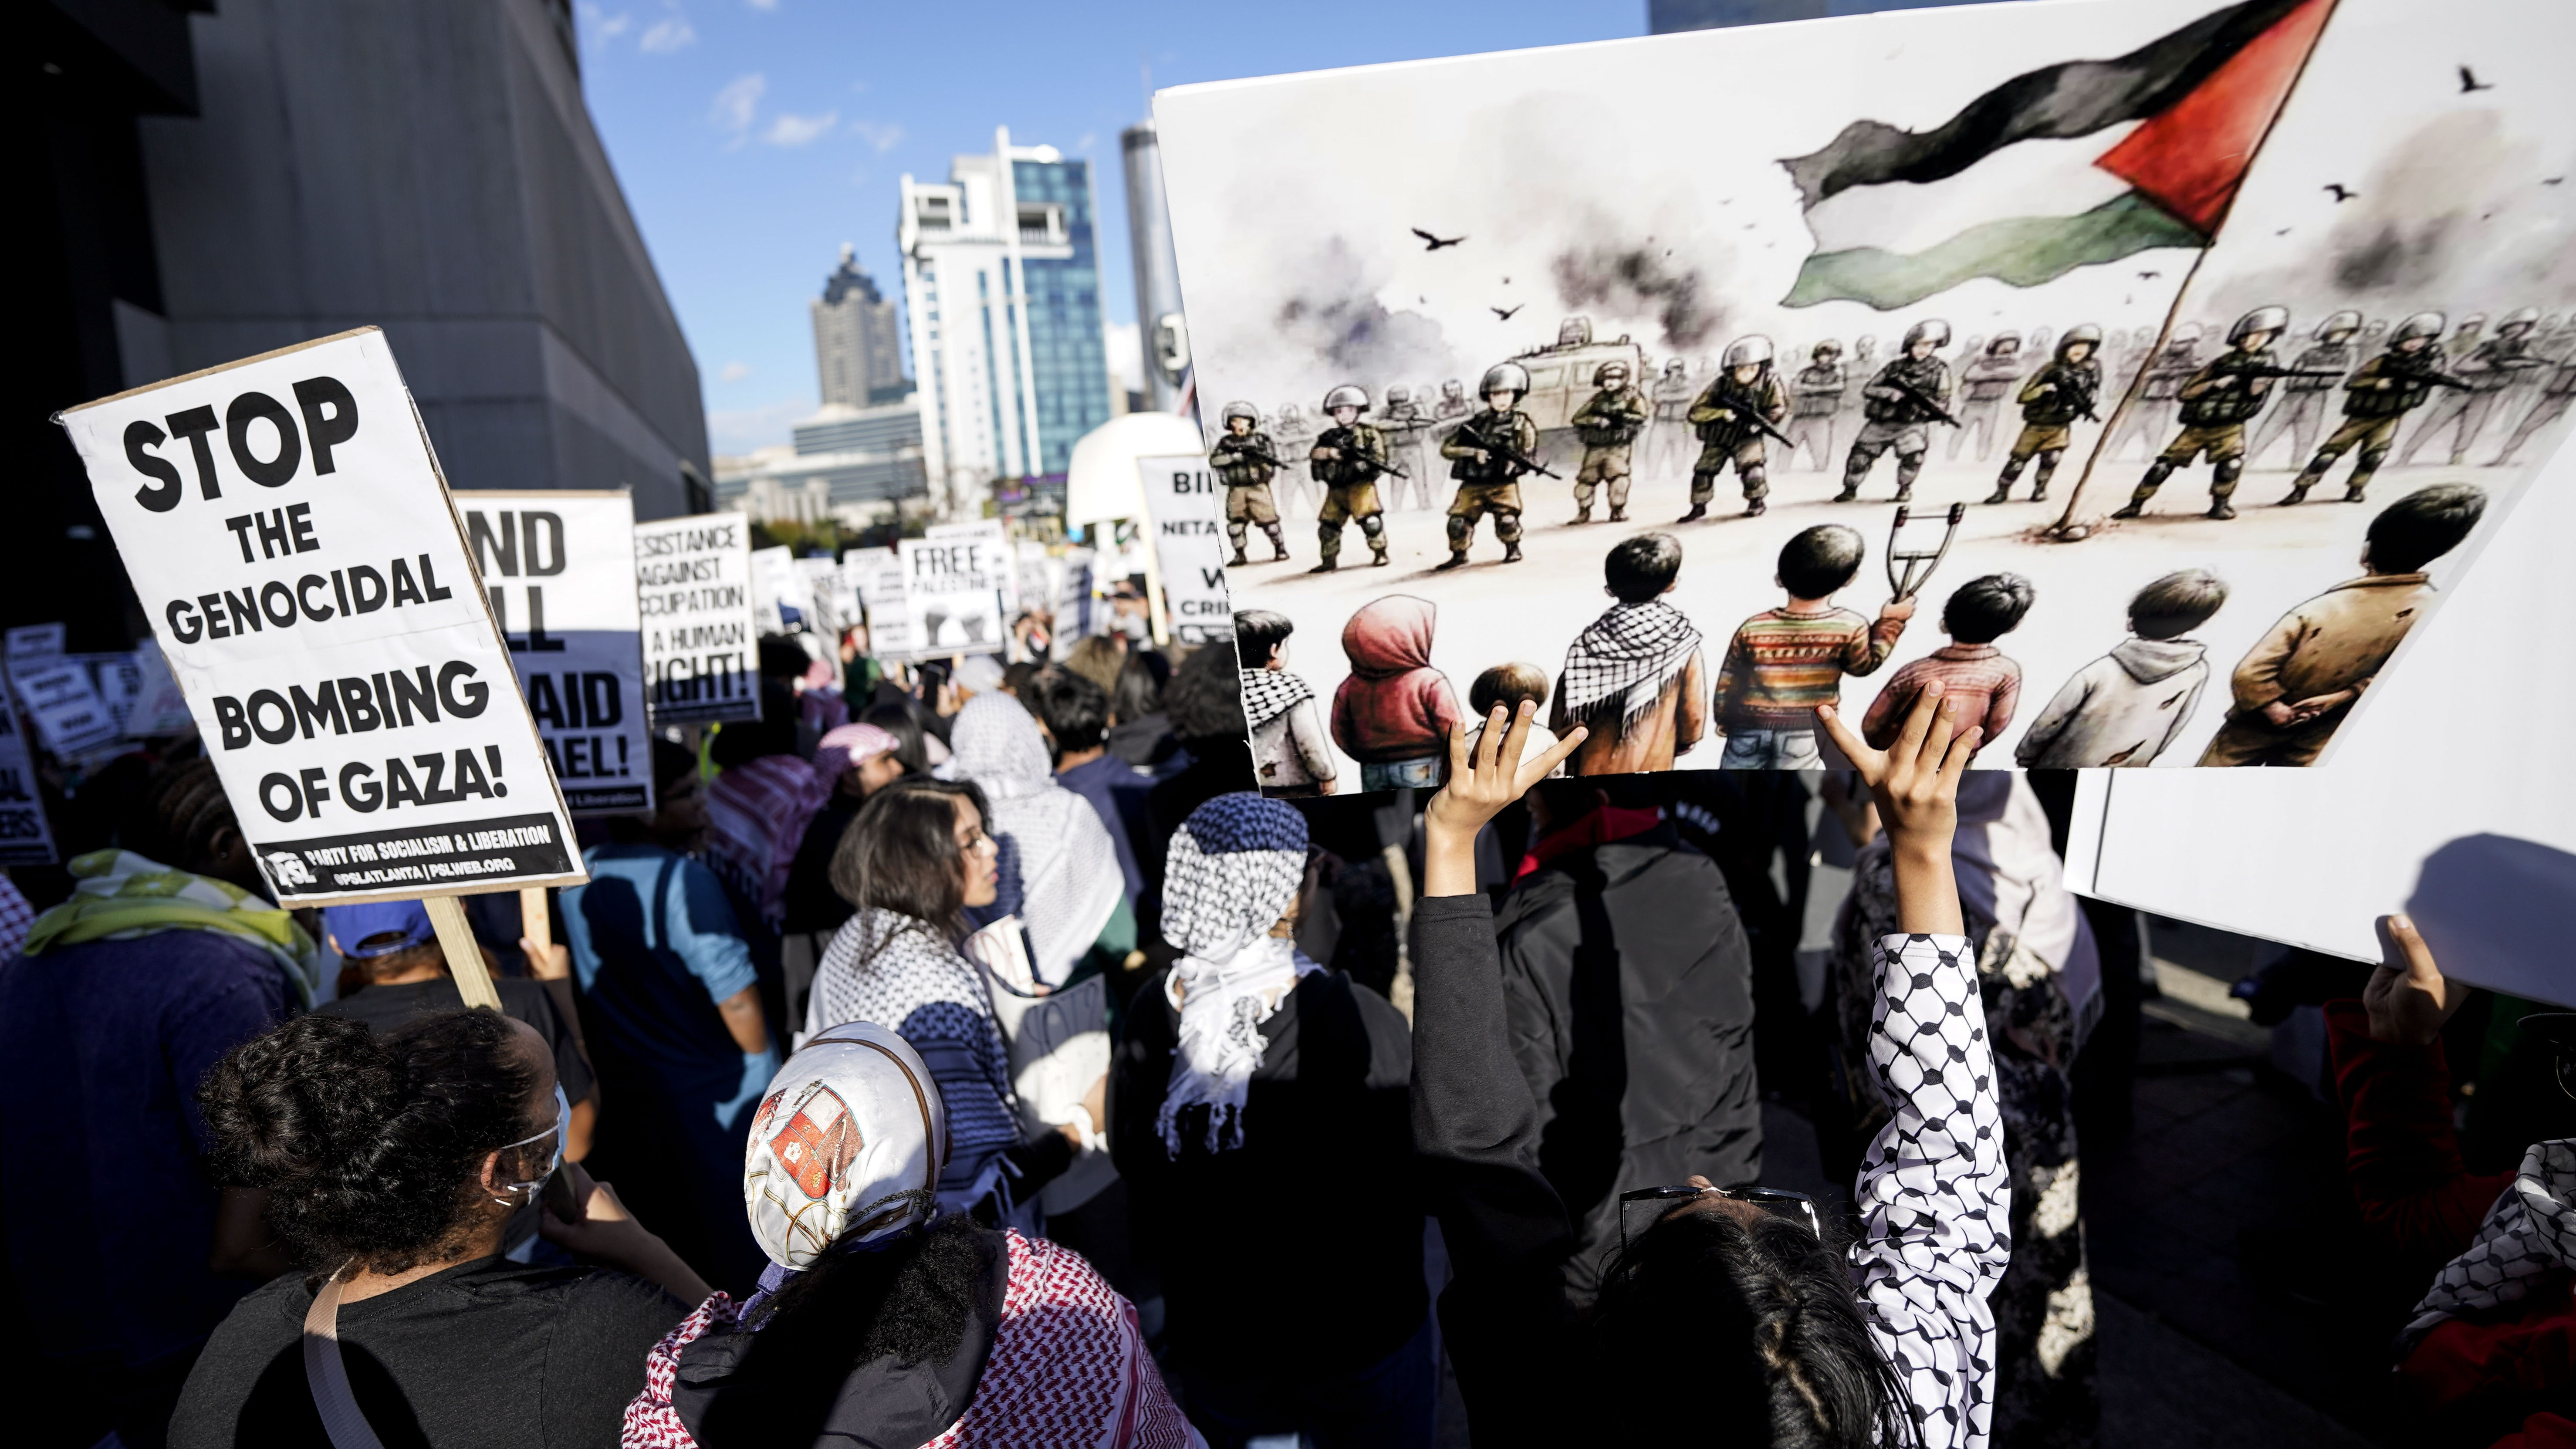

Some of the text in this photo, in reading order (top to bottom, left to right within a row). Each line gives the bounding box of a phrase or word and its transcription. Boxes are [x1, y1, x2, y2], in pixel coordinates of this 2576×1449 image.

[123, 376, 358, 513] STOP
[225, 502, 320, 563] THE
[914, 545, 981, 575] FREE
[166, 554, 452, 644] GENOCIDAL
[653, 622, 744, 652] A HUMAN
[213, 660, 489, 750] BOMBING
[528, 672, 622, 729] AID
[259, 745, 507, 823] OF GAZA!
[304, 824, 551, 866] PARTY FOR SOCIALISM & LIBERATION
[333, 864, 424, 886] @PSLATLANTA
[429, 857, 516, 878] PSLWEB.ORG
